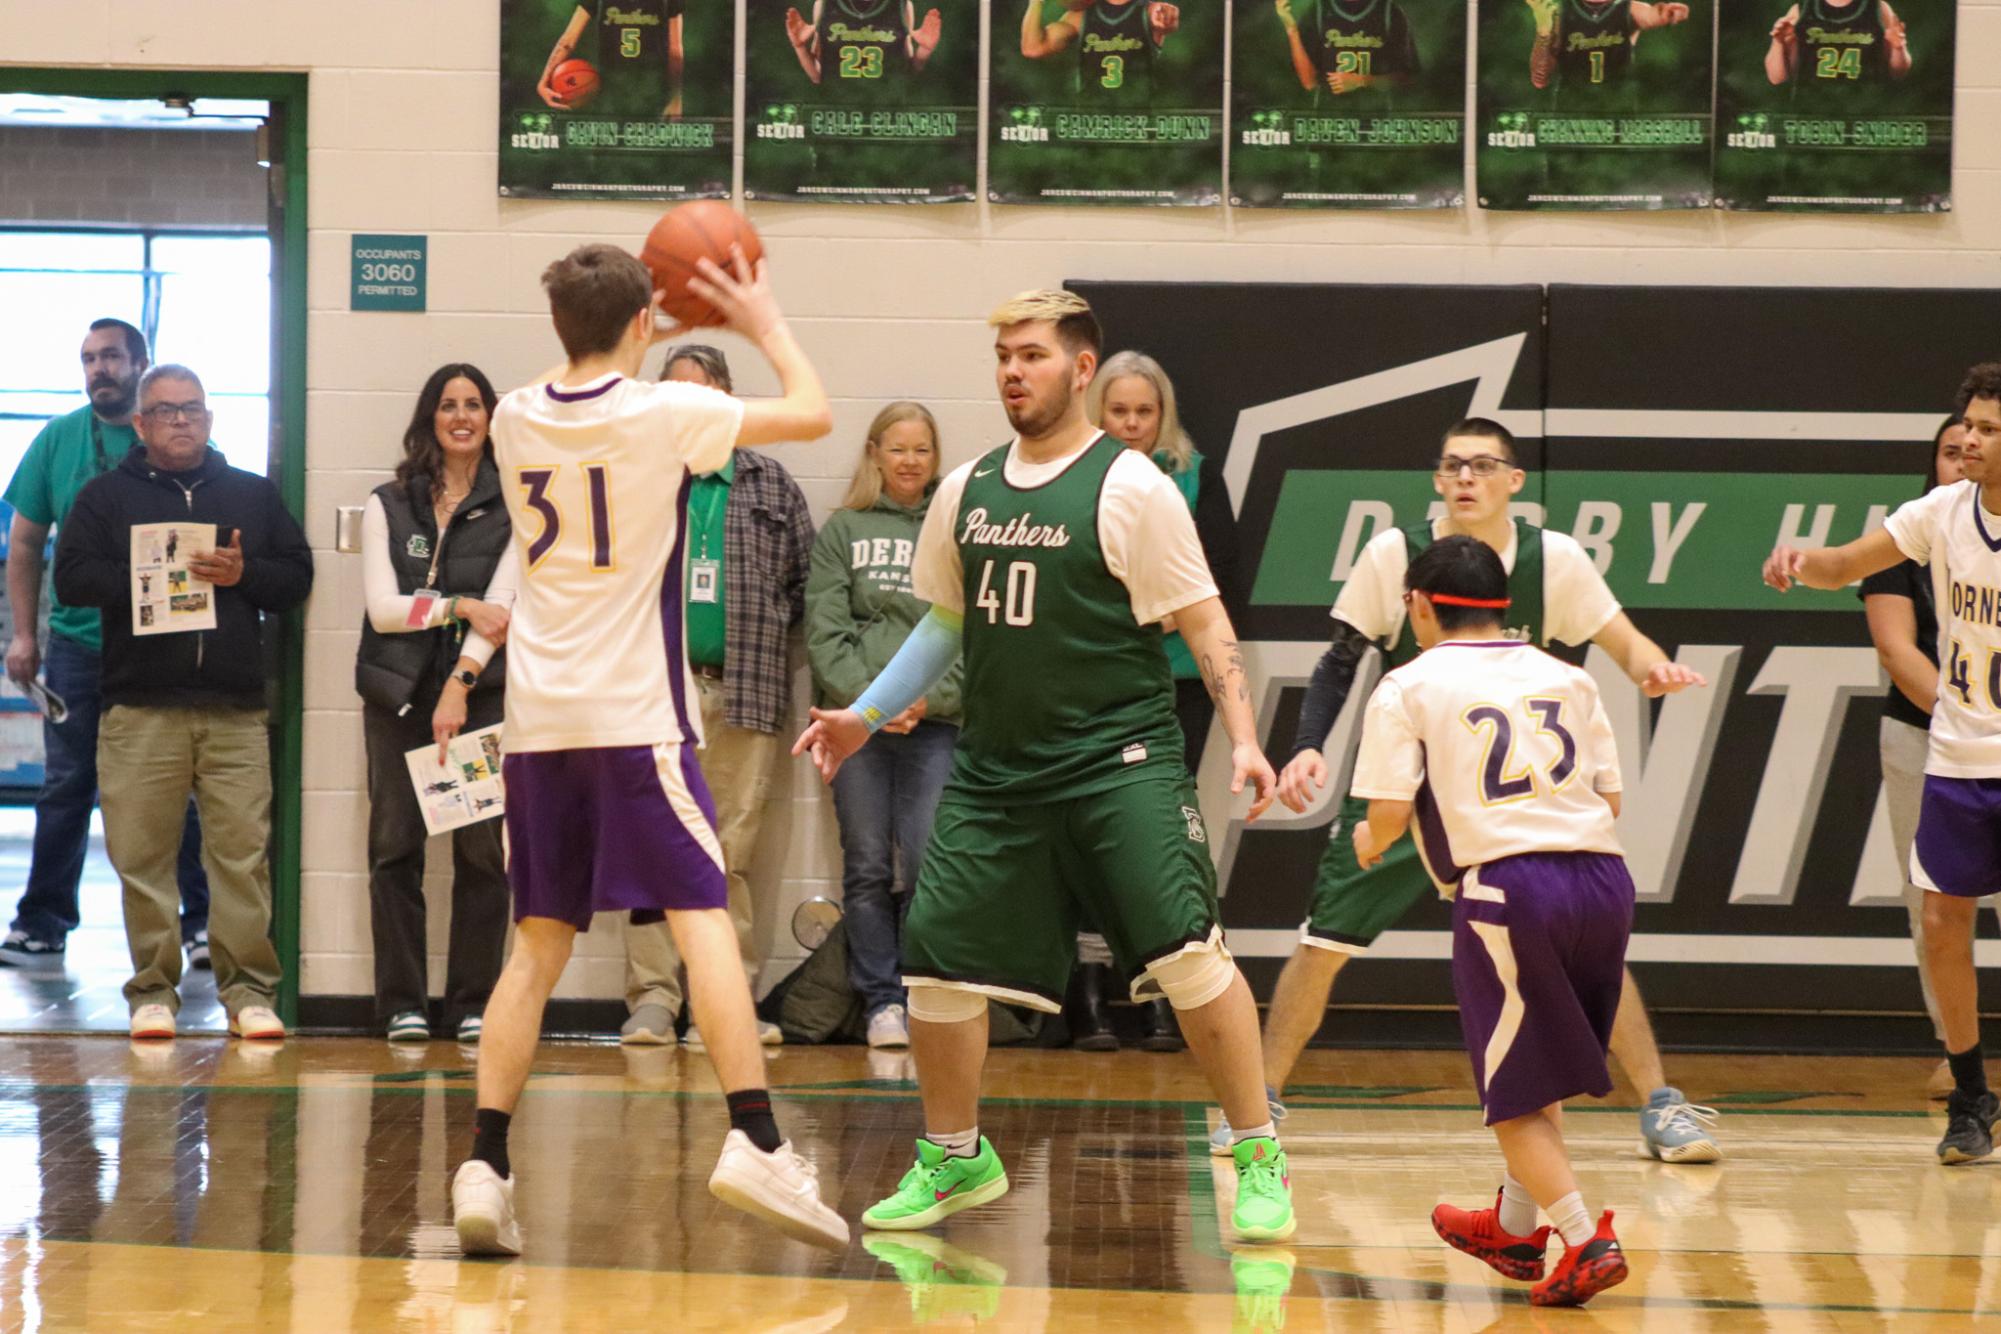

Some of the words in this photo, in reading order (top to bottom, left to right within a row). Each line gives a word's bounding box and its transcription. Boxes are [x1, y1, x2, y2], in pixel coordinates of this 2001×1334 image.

[621, 28, 641, 58] 5
[839, 46, 883, 78] 23
[1101, 55, 1124, 88] 3
[1336, 51, 1371, 76] 21
[1590, 51, 1605, 83] 1
[1816, 47, 1861, 79] 24
[811, 111, 863, 135] CALE
[1156, 116, 1210, 140] DUNN
[1368, 119, 1458, 144] JOHNSON
[355, 249, 422, 260] OCCUPANTS
[361, 263, 416, 281] 3060
[358, 285, 418, 296] PERMITTED
[513, 461, 616, 576] 31
[960, 508, 1070, 547] Panthers
[976, 560, 1037, 627] 40
[1459, 695, 1580, 808] 23
